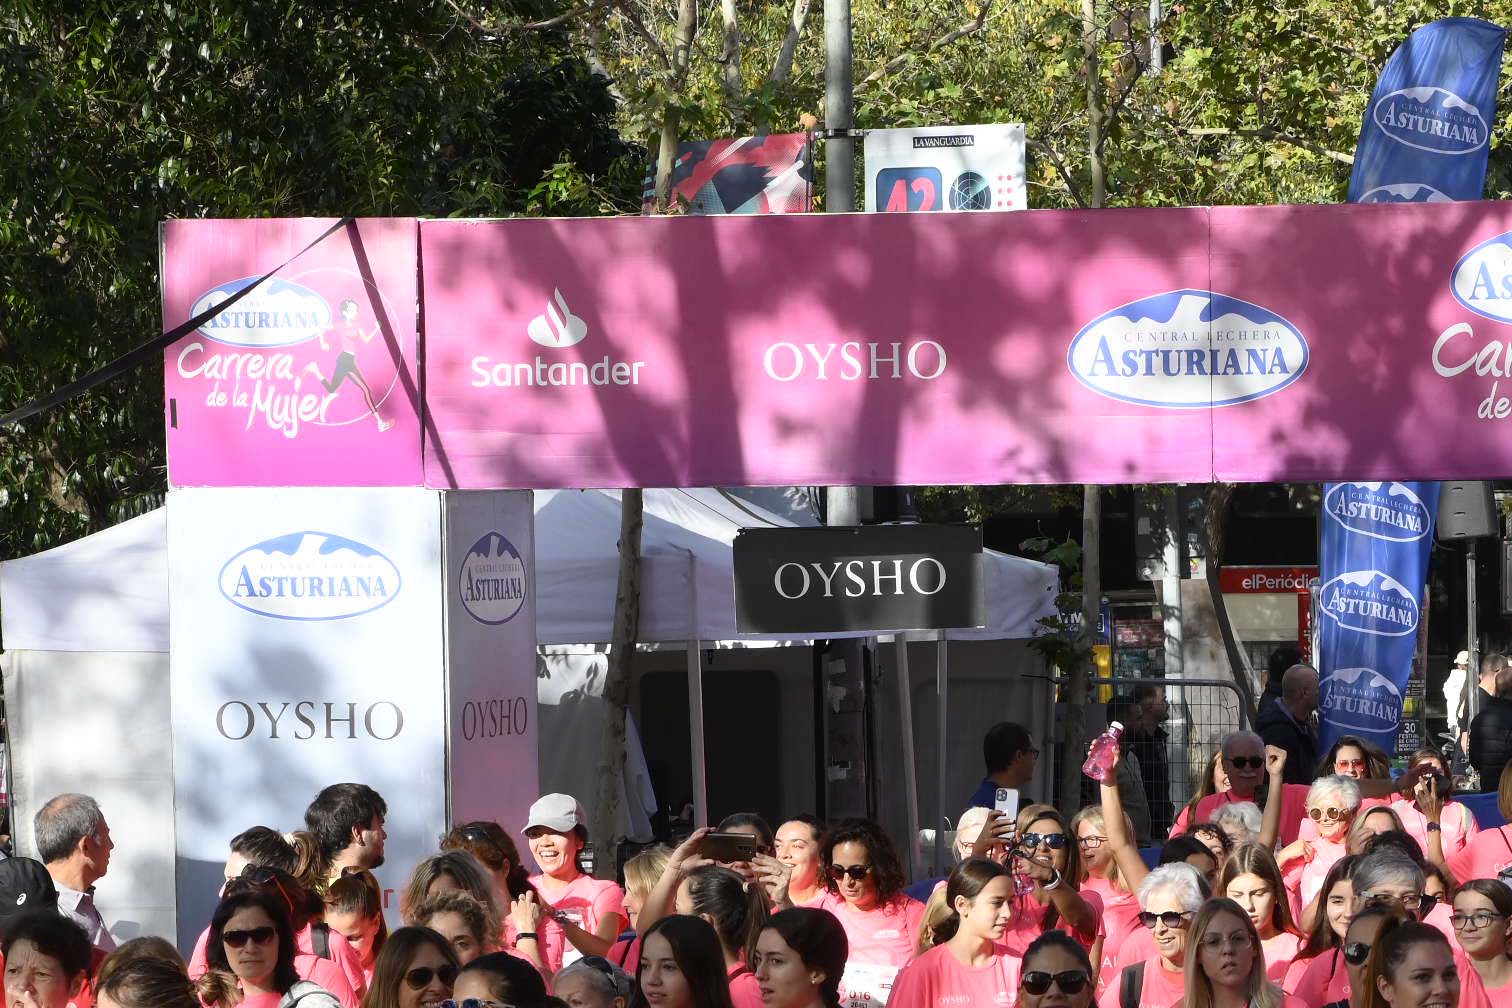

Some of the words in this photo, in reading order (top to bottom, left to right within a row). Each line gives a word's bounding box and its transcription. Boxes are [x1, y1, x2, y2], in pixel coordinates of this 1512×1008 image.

[1381, 102, 1479, 145] ASTURIANA
[199, 303, 322, 330] ASTURIANA
[1124, 330, 1199, 343] CENTRAL
[1206, 329, 1281, 342] LECHERA
[177, 343, 293, 380] Carrera
[471, 354, 645, 388] Santander
[763, 340, 948, 382] OYSHO
[1088, 335, 1291, 378] ASTURIANA
[207, 381, 228, 407] de
[233, 383, 249, 408] la
[246, 377, 340, 438] Mujer
[1477, 379, 1512, 420] de
[1335, 491, 1423, 534] ASTURIANA
[233, 564, 389, 598] ASTURIANA
[465, 566, 523, 602] ASTURIANA
[775, 556, 947, 600] OYSHO
[1327, 587, 1413, 627] ASTURIANA
[216, 700, 404, 741] OYSHO
[462, 696, 528, 742] OYSHO
[1404, 722, 1416, 734] 30
